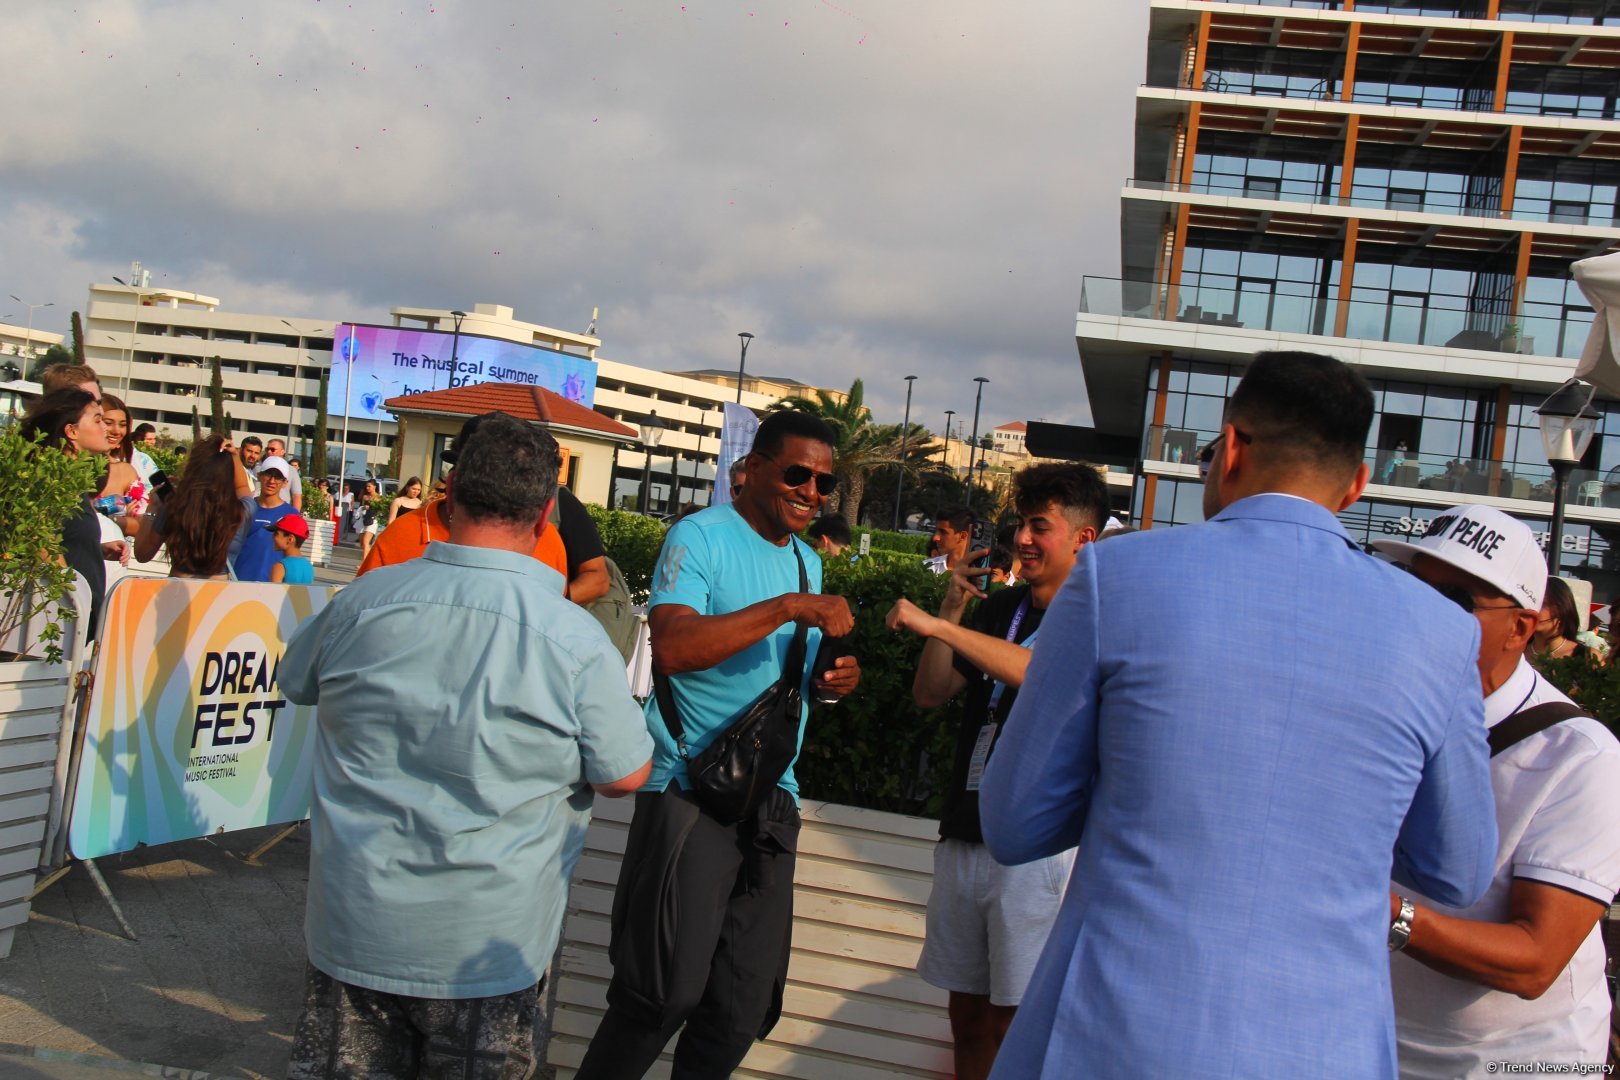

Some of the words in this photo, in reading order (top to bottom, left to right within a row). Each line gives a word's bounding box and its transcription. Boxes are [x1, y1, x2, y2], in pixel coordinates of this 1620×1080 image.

[392, 352, 418, 368] The
[422, 357, 484, 375] musical
[488, 366, 539, 384] summer
[451, 375, 470, 388] of
[1449, 517, 1506, 560] PEACE
[190, 700, 286, 749] FEST
[187, 752, 239, 768] INTERNATIONAL
[184, 770, 208, 783] MUSIC
[208, 767, 237, 780] FESTIVAL
